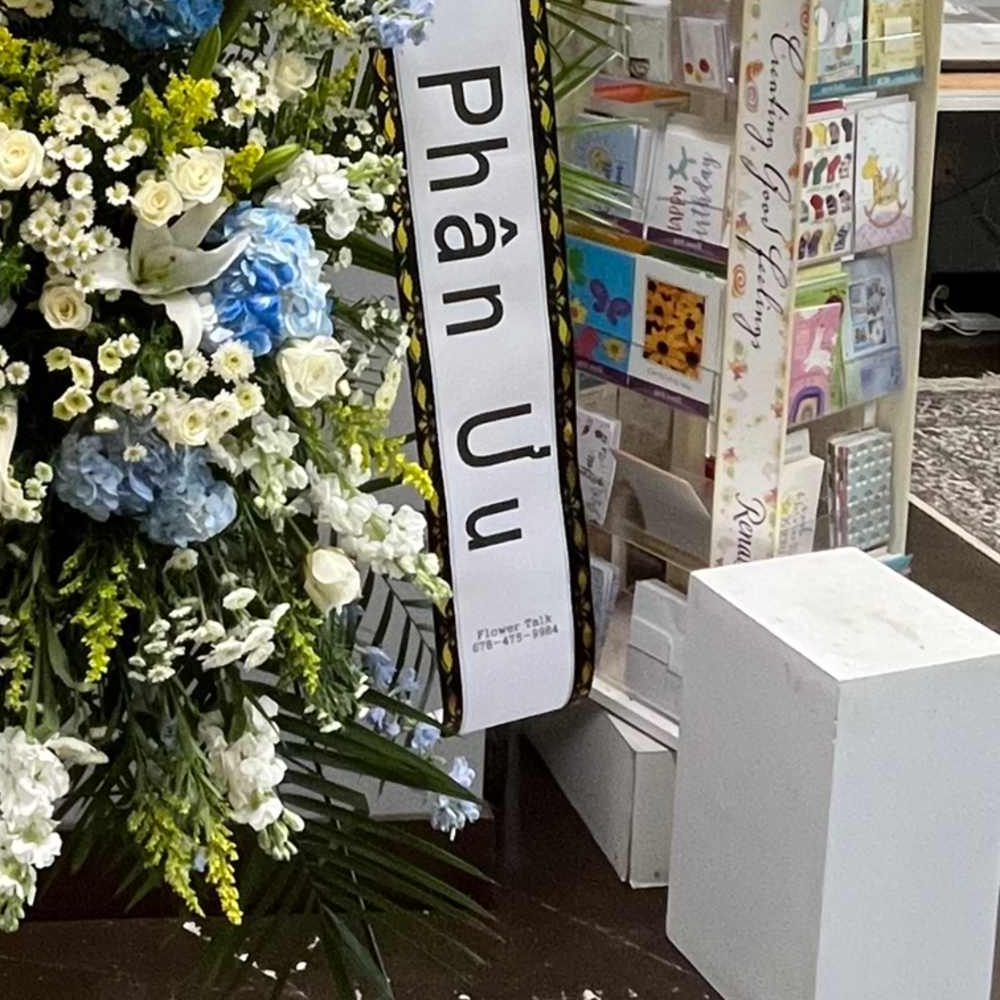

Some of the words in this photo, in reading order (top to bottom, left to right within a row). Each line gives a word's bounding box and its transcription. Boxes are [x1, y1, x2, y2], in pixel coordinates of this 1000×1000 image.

[744, 33, 805, 148] Creating
[418, 66, 517, 336] Phân
[739, 155, 792, 243] Good
[733, 234, 788, 349] Feelings
[457, 404, 550, 550] Ưu
[477, 623, 520, 640] Flower
[523, 614, 552, 629] Talk
